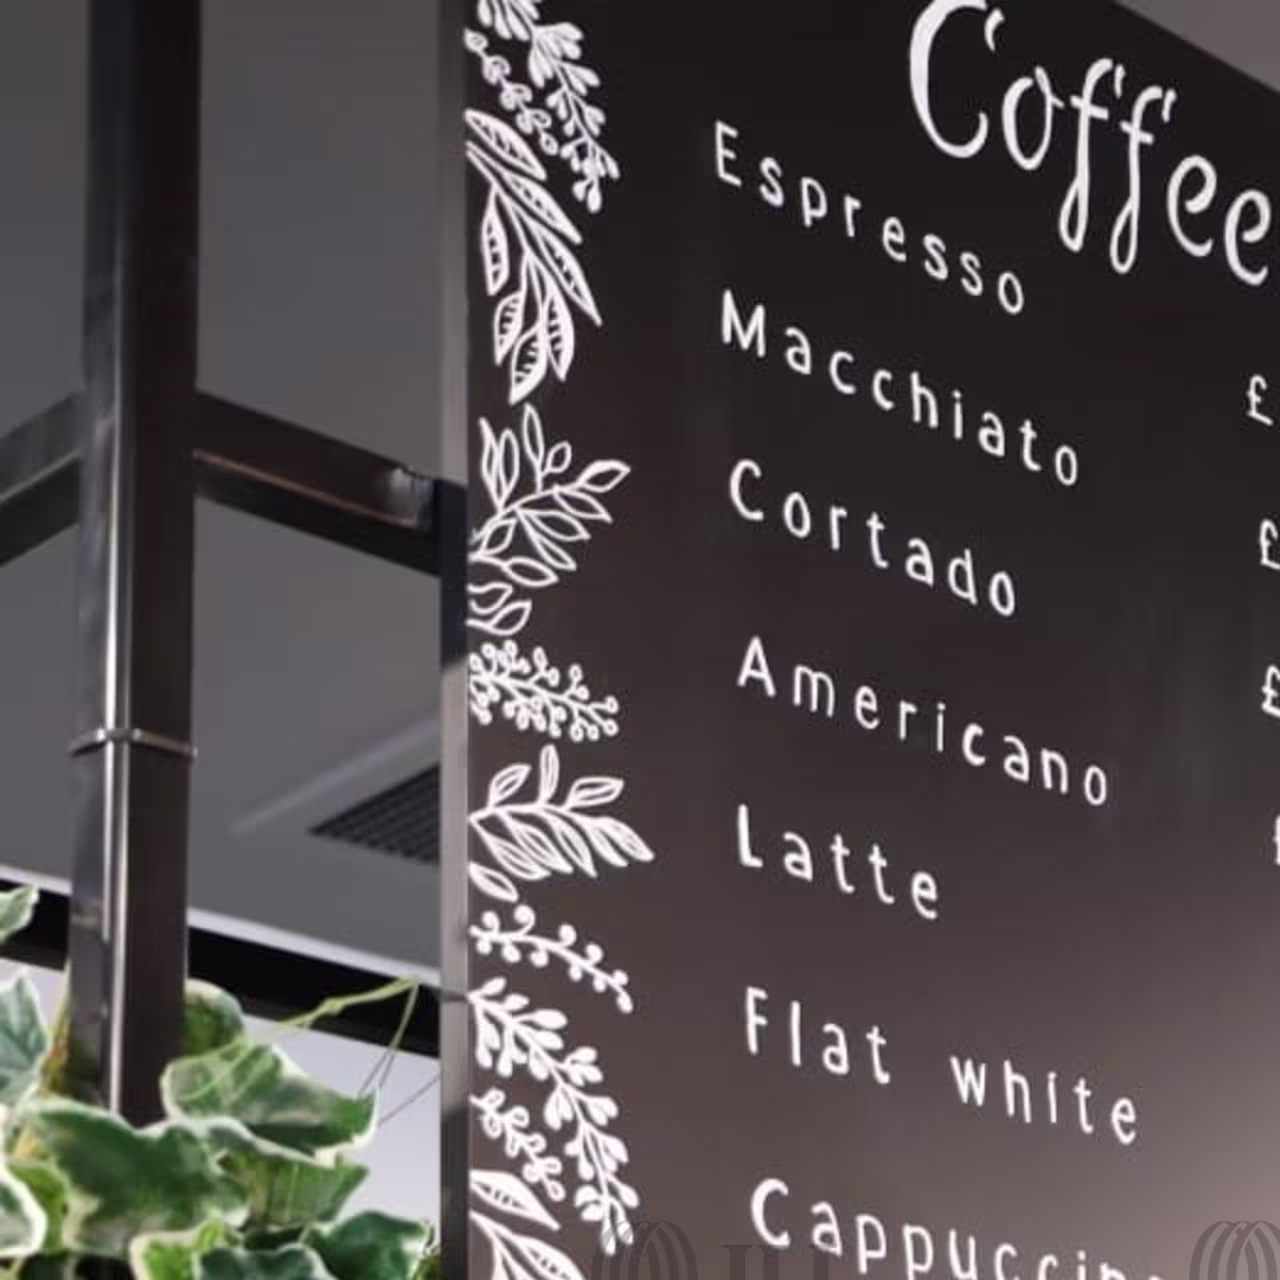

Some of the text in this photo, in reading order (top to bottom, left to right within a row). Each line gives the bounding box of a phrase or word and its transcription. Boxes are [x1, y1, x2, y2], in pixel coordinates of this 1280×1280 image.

[715, 122, 1025, 314] Espresso
[909, 0, 1271, 286] Coffee
[721, 290, 1078, 486] Macchiato
[729, 459, 1016, 617] Cortado
[737, 636, 1107, 806] Americano
[737, 804, 938, 920] Latte
[745, 986, 891, 1085] Flat
[949, 1056, 1136, 1145] white
